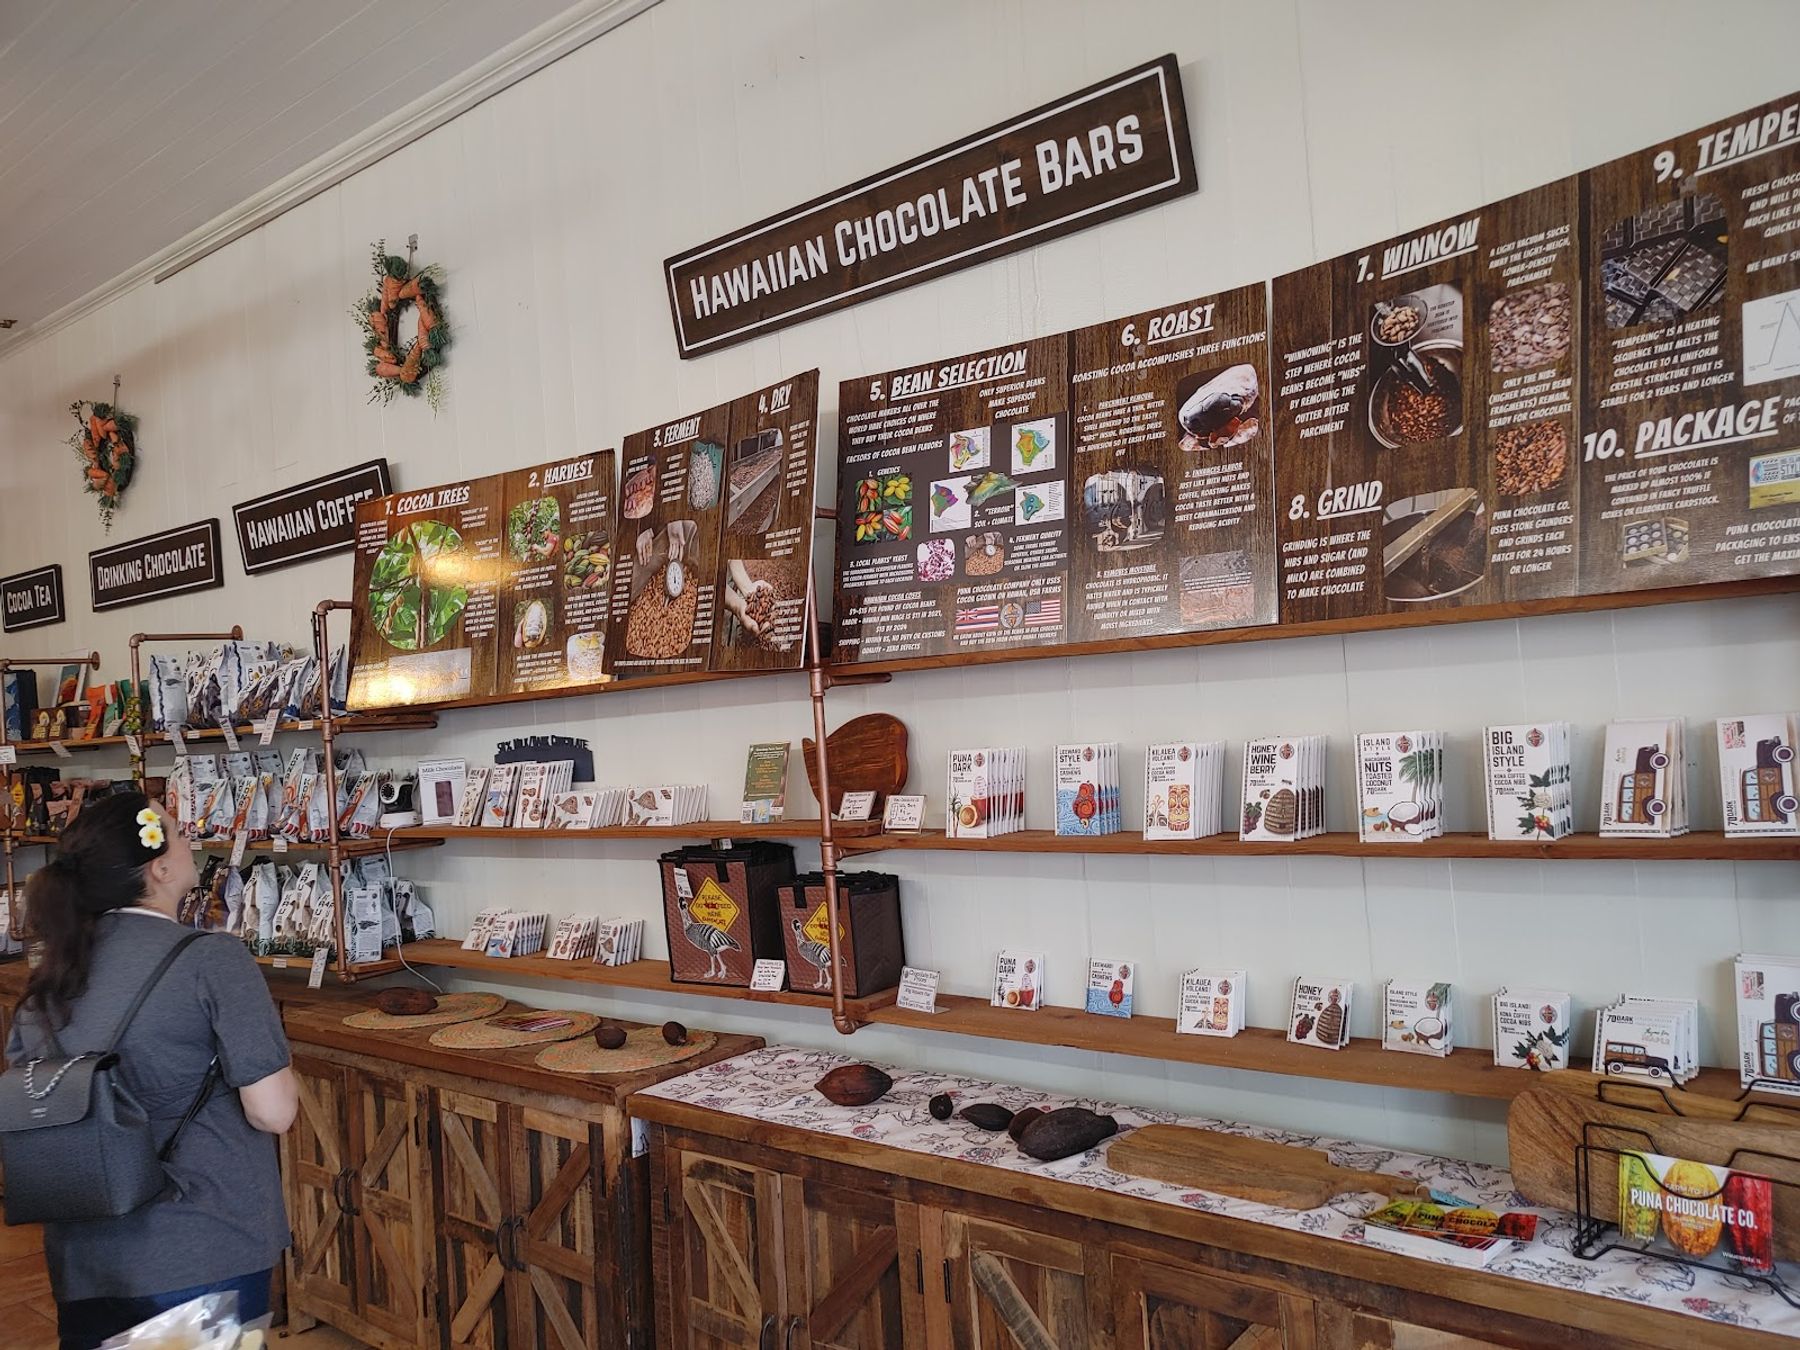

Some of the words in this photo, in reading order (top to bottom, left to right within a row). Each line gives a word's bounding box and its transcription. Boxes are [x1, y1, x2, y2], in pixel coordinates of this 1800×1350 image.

[1654, 151, 1683, 183] 9.
[1697, 104, 1800, 169] TEMPE
[690, 235, 828, 319] HAWAIIAN
[835, 159, 1027, 266] CHOCOLATE
[1036, 114, 1143, 194] BARS
[1356, 256, 1374, 283] 7.
[1382, 217, 1480, 274] WINNOW
[1121, 324, 1140, 346] 6.
[1148, 303, 1215, 341] ROAST
[1612, 329, 1665, 348] "TEMPERING"
[1666, 327, 1676, 336] IS
[1685, 316, 1720, 331] HEATING
[1072, 369, 1109, 383] ROASTING
[1110, 363, 1136, 375] COCOA
[1137, 348, 1194, 369] ACCOMPLISHES
[1196, 343, 1220, 357] THREE
[1222, 331, 1266, 349] FUNCTIONS
[1284, 339, 1337, 364] "WINNOWING"
[1337, 337, 1348, 349] IS
[1349, 332, 1363, 345] THE
[1613, 347, 1652, 363] SEQUENCE
[1653, 342, 1673, 353] THAT
[1675, 335, 1701, 349] MELTS
[1704, 330, 1719, 341] THE
[1285, 366, 1302, 379] STEP
[1304, 358, 1332, 375] WEHERE
[1334, 350, 1360, 366] COCOA
[1614, 360, 1658, 377] CHOCOLATE
[1660, 358, 1671, 366] TO
[1672, 355, 1678, 364] A
[1680, 346, 1718, 362] UNIFORM
[870, 381, 885, 400] 5.
[891, 369, 934, 398] BEAN
[938, 349, 1027, 388] SELECTION
[1280, 381, 1304, 396] BEANS
[1305, 373, 1335, 390] BECOME
[1338, 365, 1366, 382] "NIBS"
[1610, 378, 1643, 392] CRYSTAL
[1644, 366, 1689, 384] STRUCTURE
[1691, 362, 1712, 373] THAT
[1714, 360, 1724, 369] IS
[759, 394, 768, 413] 4.
[770, 384, 792, 411] DRY
[979, 388, 994, 398] ONLY
[996, 382, 1025, 394] SUPERIOR
[1026, 377, 1046, 388] BEANS
[1290, 399, 1299, 410] BY
[1300, 388, 1340, 407] REMOVING
[1342, 384, 1356, 397] THE
[1600, 395, 1628, 408] STABLE
[1629, 391, 1645, 402] FOR
[1647, 390, 1654, 399] 2
[1655, 384, 1680, 396] YEARS
[1681, 380, 1699, 391] AND
[1701, 372, 1735, 387] LONGER
[847, 411, 877, 423] CHOCOLATE
[878, 407, 900, 418] MAKERS
[902, 403, 912, 413] ALL
[913, 401, 927, 412] OVER
[928, 399, 939, 408] THE
[988, 399, 1006, 408] MAKE
[1007, 392, 1036, 405] SUPERIOR
[849, 424, 867, 434] WORLD
[884, 416, 906, 428] CHOICES
[908, 416, 916, 424] ON
[918, 411, 937, 422] WHERE
[995, 406, 1030, 419] CHOCOLATE
[1295, 410, 1322, 424] OUTTER
[1323, 402, 1349, 418] BITTER
[654, 430, 661, 448] 3.
[664, 416, 700, 444] FERMENT
[1300, 420, 1345, 439] PARCHMENT
[1584, 428, 1625, 462] 10.
[1635, 396, 1781, 454] PACKAGE
[846, 452, 871, 463] FACTORS
[872, 451, 880, 459] OF
[881, 447, 900, 457] COCOA
[902, 445, 917, 454] BEAN
[918, 440, 943, 452] FLAVORS
[529, 472, 540, 488] 2.
[544, 459, 593, 484] HARVEST
[385, 501, 393, 515] 1.
[397, 493, 433, 514] COCOA
[437, 486, 470, 506] TREES
[1289, 494, 1310, 520] 8.
[1317, 480, 1383, 516] GRIND
[1493, 508, 1512, 520] PUNA
[1513, 504, 1556, 518] CHOCOLATE
[1557, 501, 1570, 511] CO.
[246, 511, 315, 550] HAWAIIAN
[316, 488, 373, 530] COFF
[1491, 523, 1509, 535] USES
[1510, 519, 1534, 532] STONE
[1536, 515, 1574, 529] GRINDERS
[1283, 537, 1318, 553] GRINDING
[1320, 536, 1328, 546] IS
[1329, 532, 1355, 546] WHERE
[1356, 530, 1371, 540] THE
[1498, 536, 1514, 548] AND
[1515, 533, 1544, 546] GRINDS
[1545, 530, 1565, 542] EACH
[1284, 556, 1301, 568] NIBS
[1303, 553, 1319, 565] AND
[1320, 550, 1346, 563] SUGAR
[1348, 547, 1368, 561] (AND
[1491, 550, 1515, 562] BATCH
[1516, 548, 1531, 559] FOR
[1533, 547, 1544, 558] 24
[1546, 544, 1572, 556] HOURS
[97, 559, 142, 591] DRINKING
[144, 543, 206, 578] CHOCOLATE
[1286, 571, 1308, 584] MILK)
[1310, 569, 1324, 580] ARE
[1326, 564, 1366, 578] COMBINED
[1510, 565, 1521, 574] OR
[1522, 562, 1552, 573] LONGER
[7, 590, 33, 613] COCOA
[34, 584, 52, 606] TEA
[1287, 589, 1297, 600] TO
[1298, 586, 1320, 598] MAKE
[1321, 581, 1364, 595] CHOCOLATE
[1251, 745, 1277, 753] HONEY
[1363, 738, 1391, 746] ISLAND
[1492, 731, 1512, 744] BIG
[953, 754, 972, 762] PUNA
[1251, 754, 1276, 764] WINE
[1492, 746, 1524, 755] ISLAND
[1493, 756, 1524, 767] STYLE
[953, 763, 972, 772] DARK
[1250, 765, 1276, 774] BERRY
[1365, 762, 1392, 772] NUTS
[999, 965, 1015, 974] DARK
[1299, 985, 1323, 994] HONEY
[1630, 1188, 1663, 1210] PUNA
[1665, 1195, 1735, 1224] CHOCOLATE
[1737, 1209, 1758, 1229] CO.
